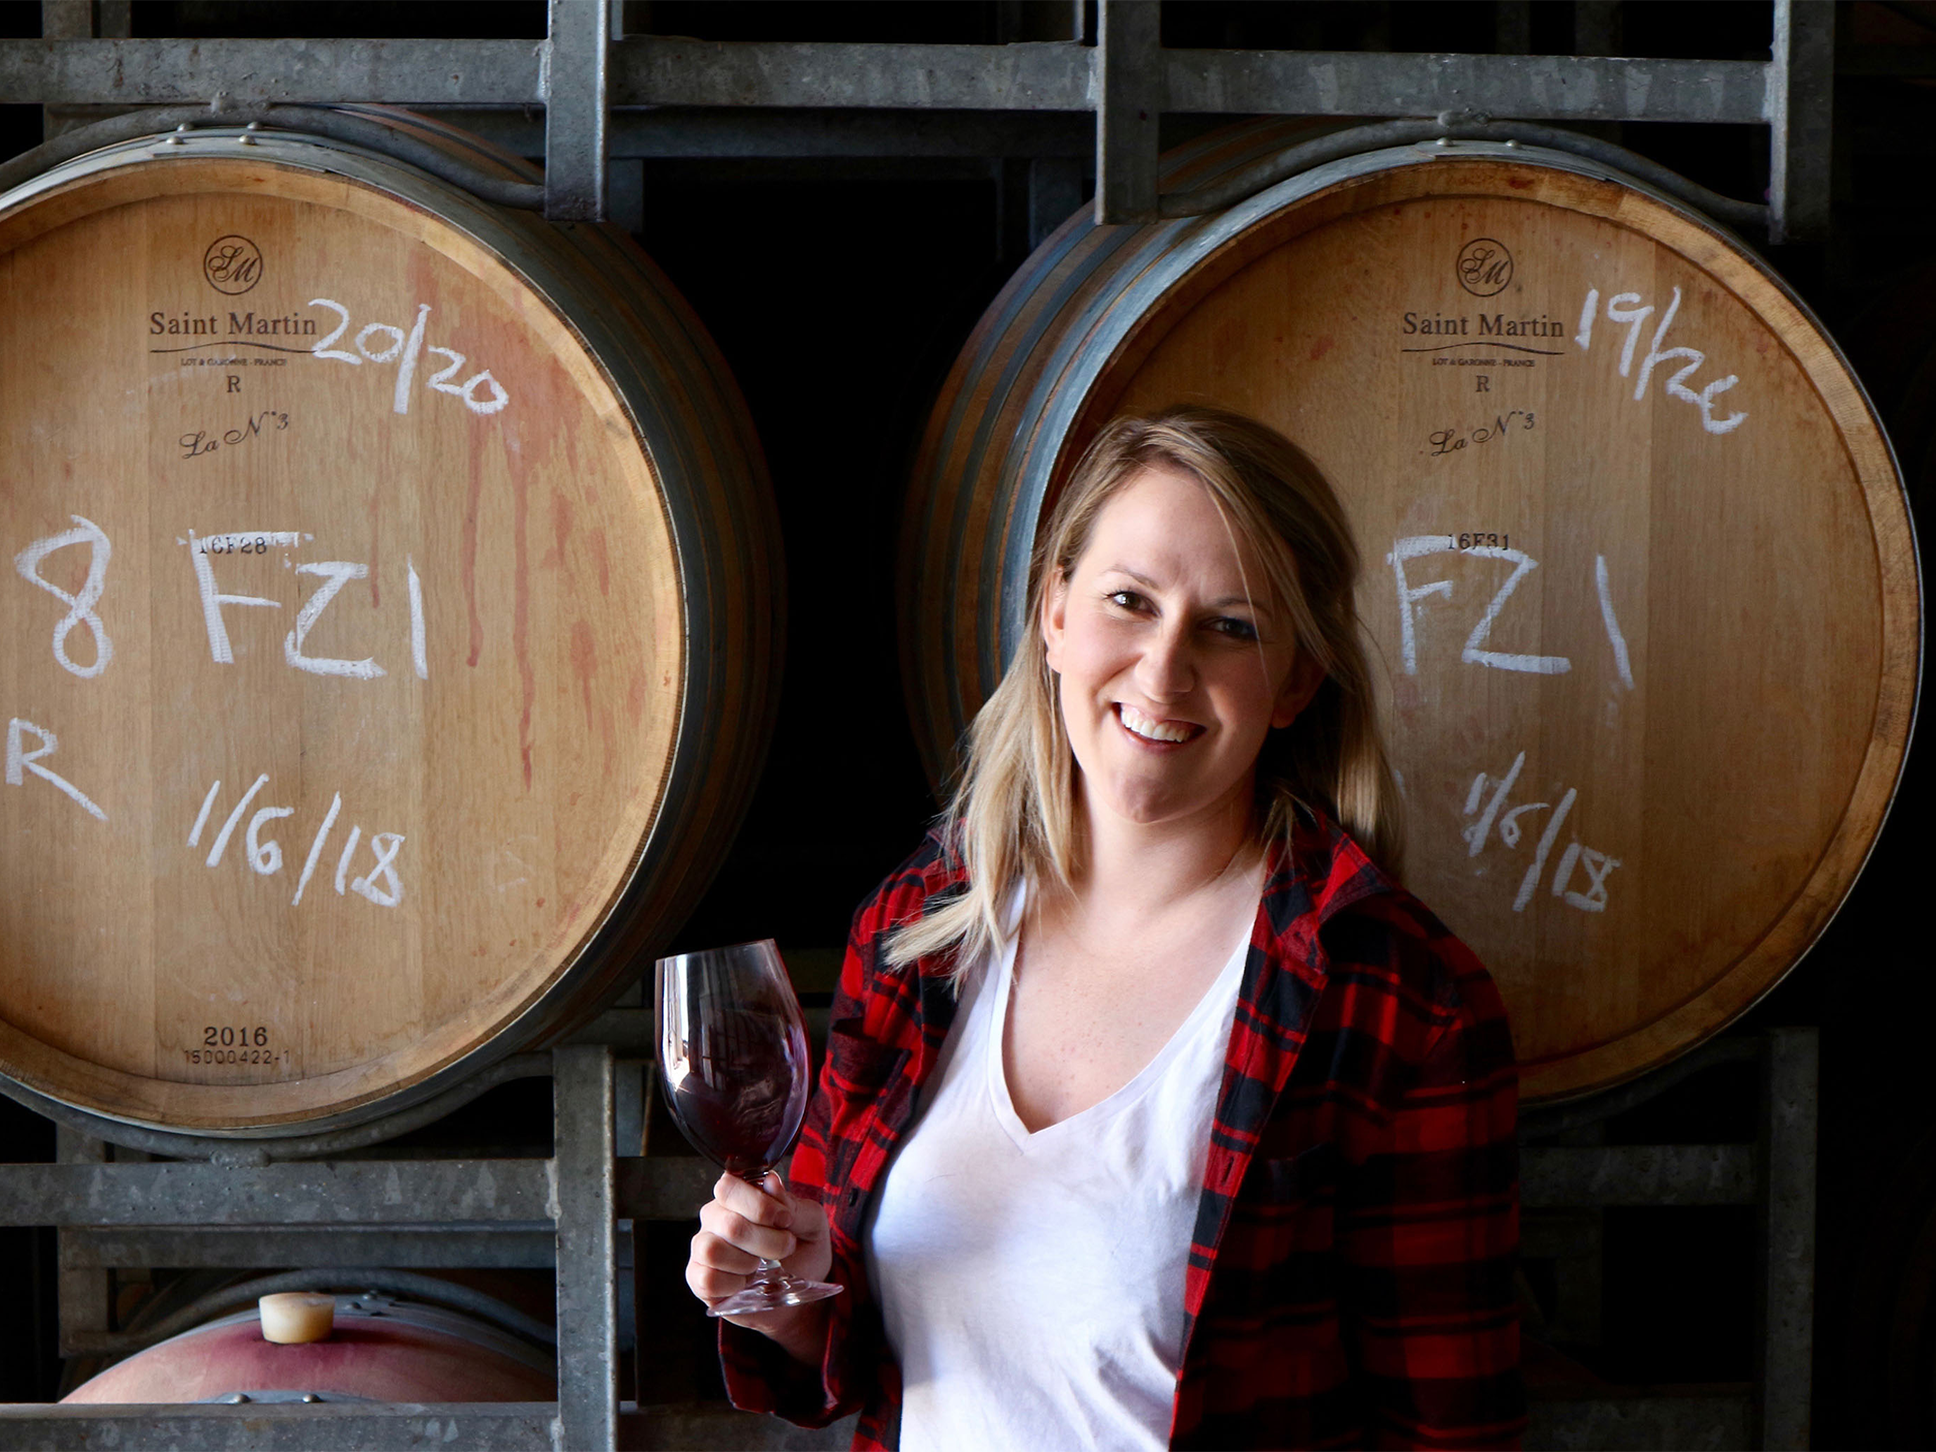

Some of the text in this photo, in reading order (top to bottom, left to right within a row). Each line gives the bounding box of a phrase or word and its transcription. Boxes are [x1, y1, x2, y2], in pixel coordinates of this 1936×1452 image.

[150, 311, 316, 336] Saint Martin
[1403, 311, 1564, 338] Saint Martin
[181, 358, 197, 366] LOT
[1432, 358, 1448, 366] LOT
[1503, 359, 1535, 367] FRANCE
[226, 375, 241, 393] R
[1476, 375, 1490, 393] R
[179, 430, 220, 459] La
[1428, 428, 1468, 457] La
[14, 513, 115, 679] 8
[5, 717, 108, 821] R
[203, 1026, 268, 1047] 2016
